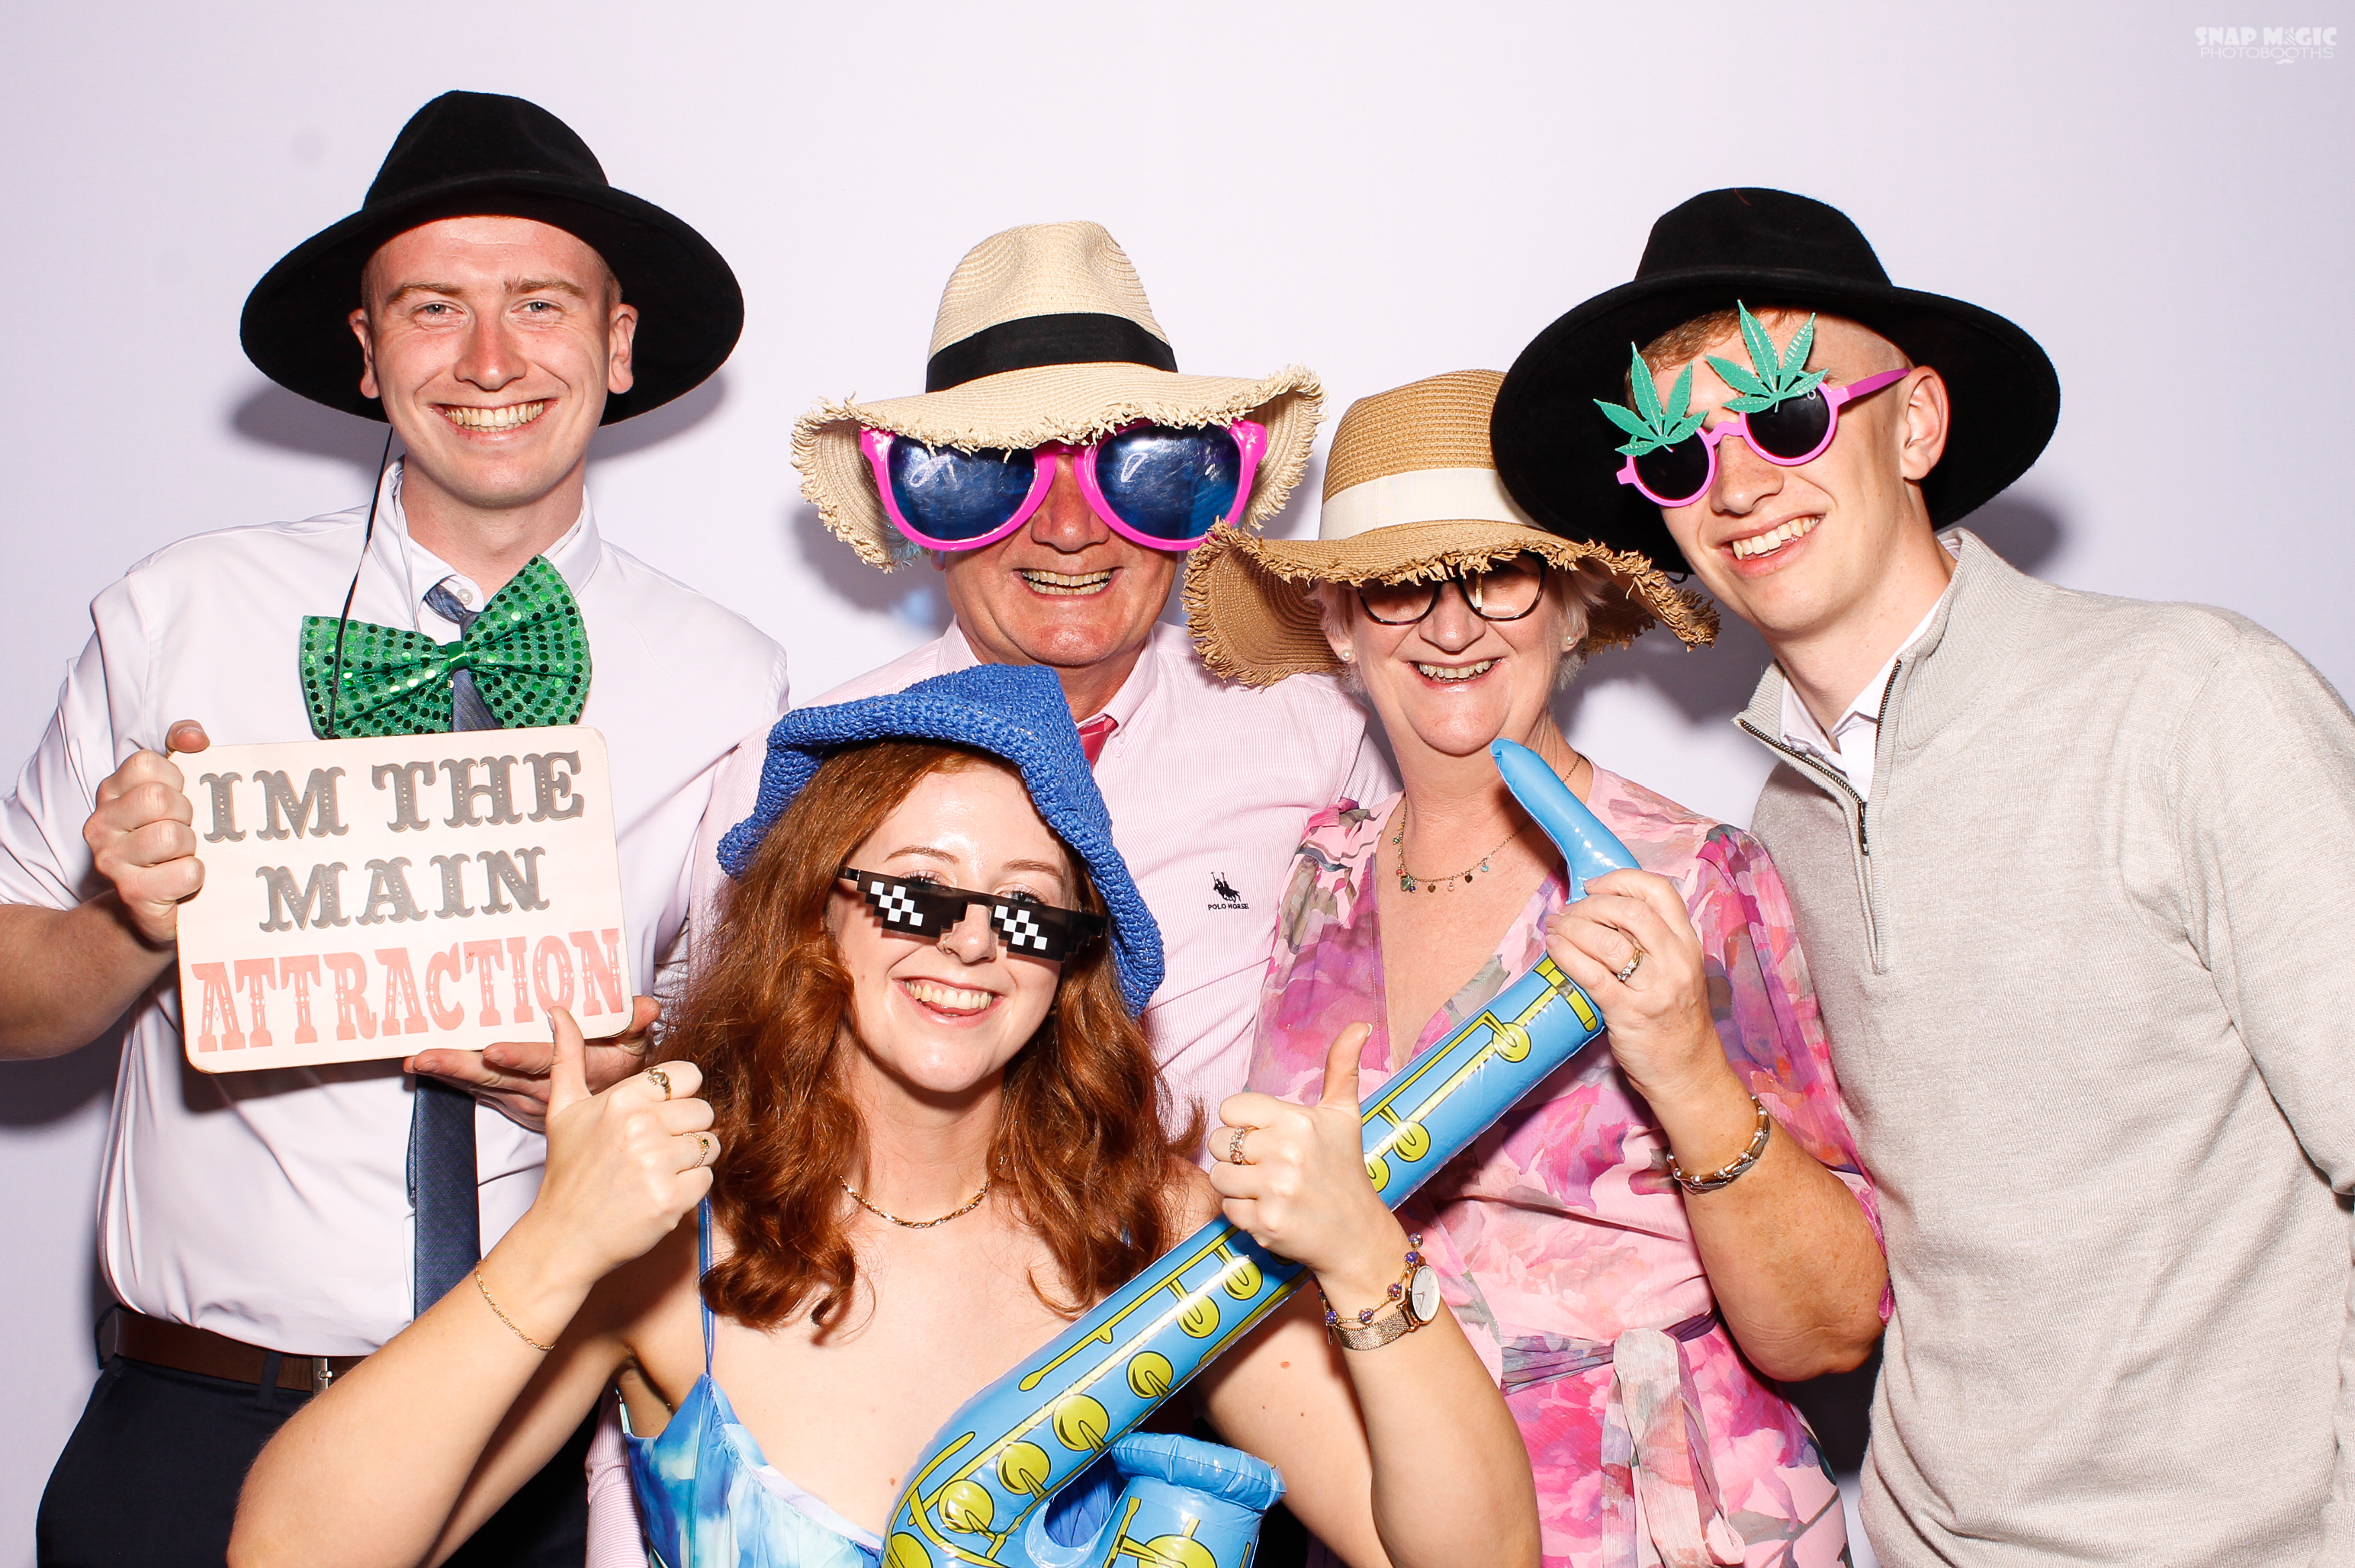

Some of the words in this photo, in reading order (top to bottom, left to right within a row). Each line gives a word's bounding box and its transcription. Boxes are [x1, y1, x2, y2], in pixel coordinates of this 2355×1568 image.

[199, 766, 349, 843] IM
[371, 750, 585, 833] THE
[255, 846, 550, 933] MAIN
[191, 928, 624, 1053] ATTRACTION
